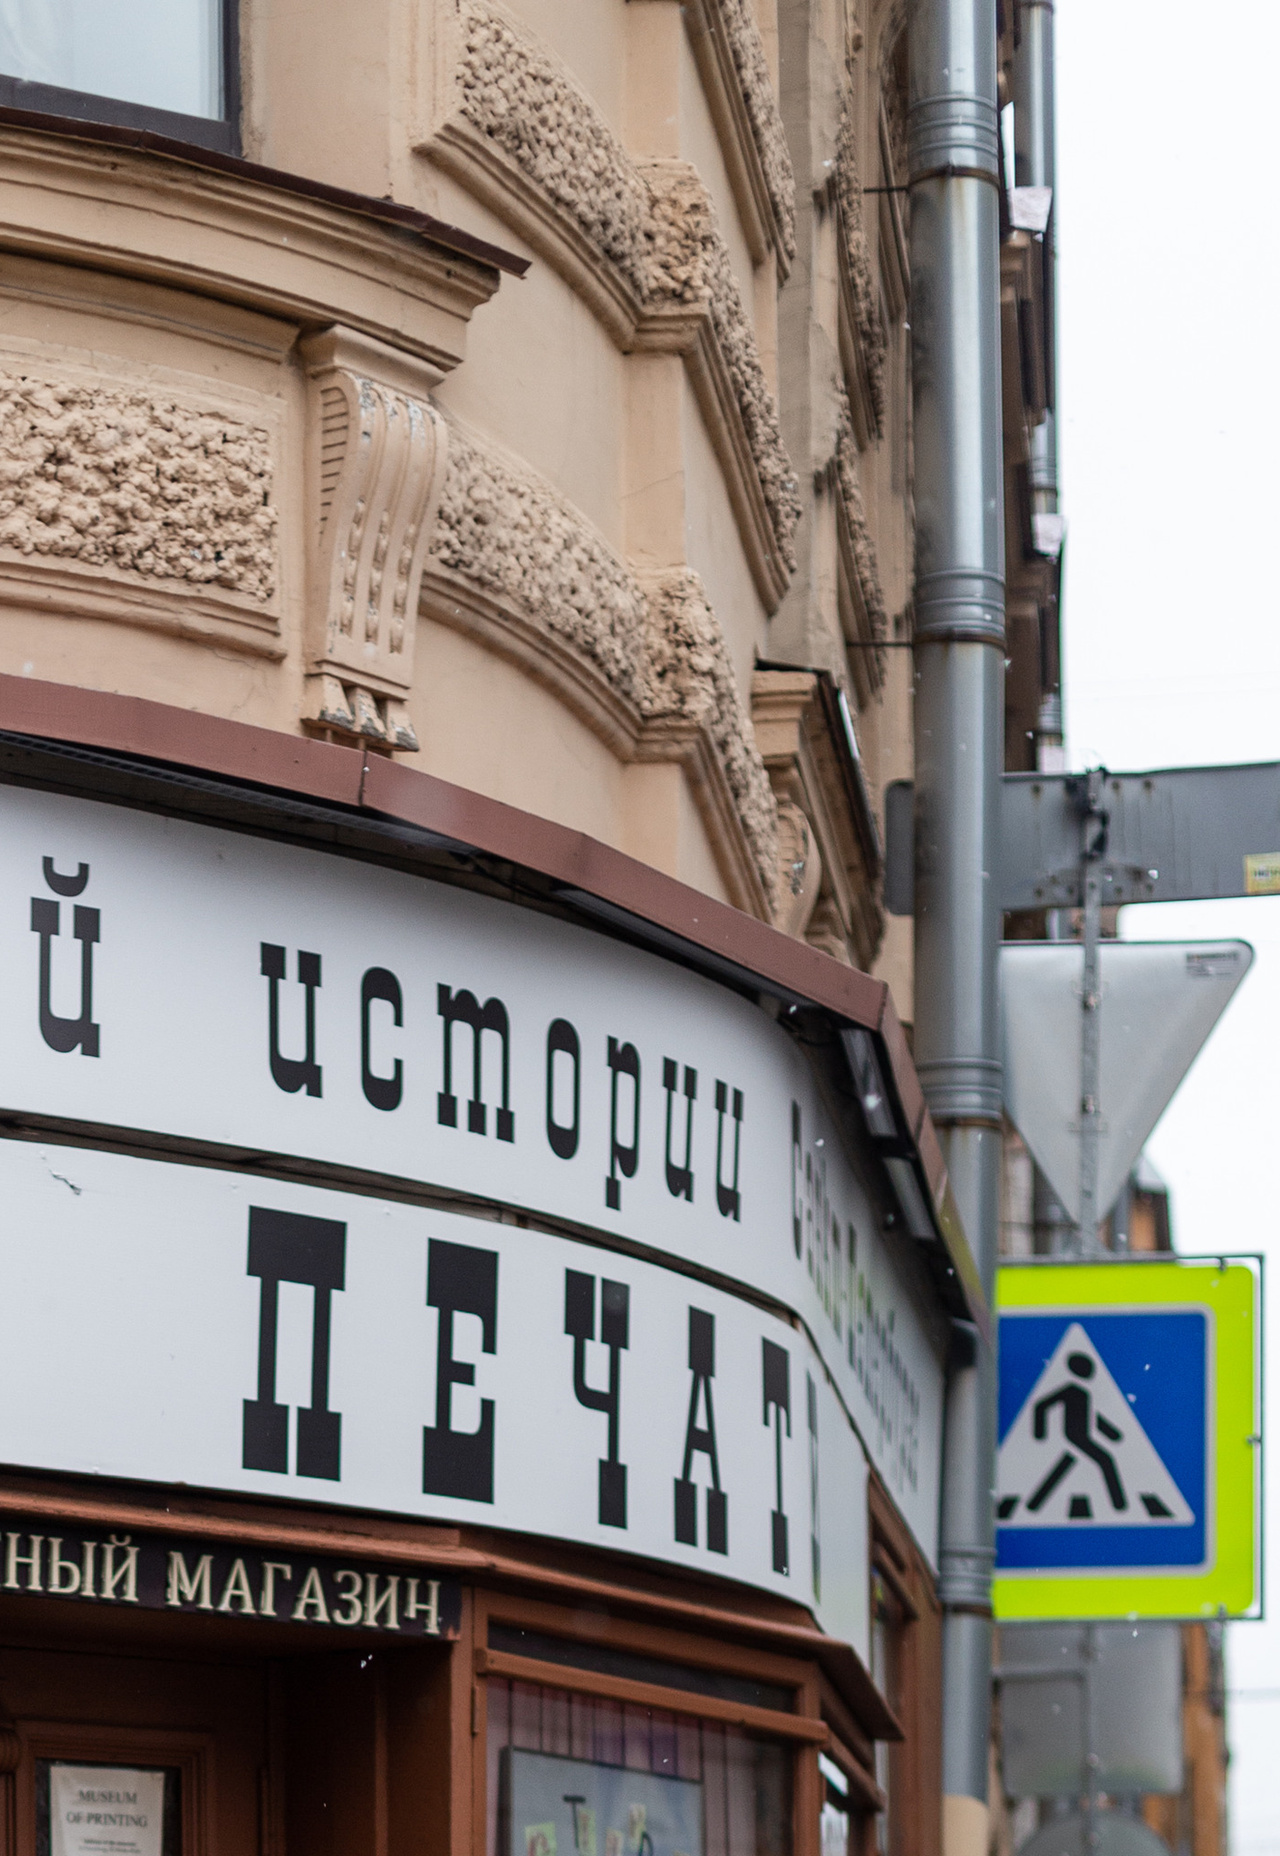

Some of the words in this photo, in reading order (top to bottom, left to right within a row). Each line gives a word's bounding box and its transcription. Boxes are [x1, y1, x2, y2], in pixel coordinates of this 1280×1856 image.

[260, 941, 744, 1222] истории
[165, 1550, 443, 1636] МАГАЗИН
[65, 1811, 83, 1824] OF
[87, 1813, 148, 1828] PRINTING
[78, 1789, 138, 1804] MUSEUM
